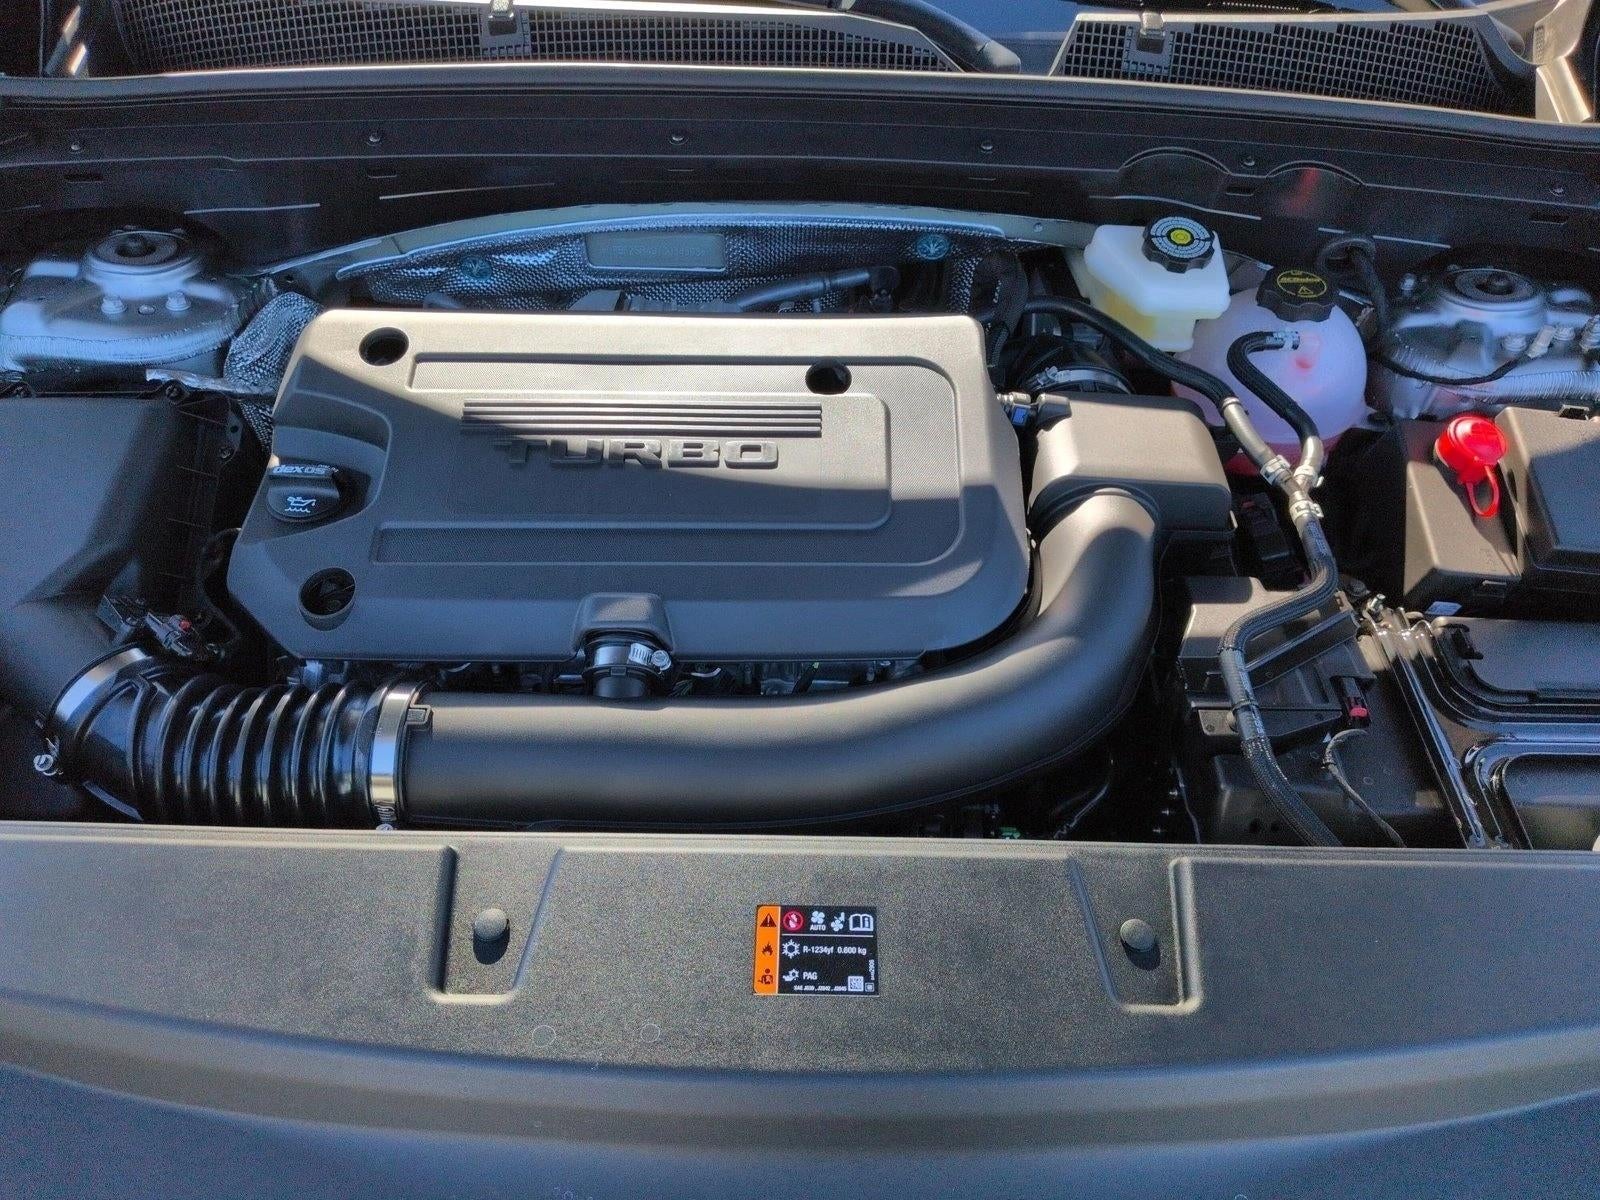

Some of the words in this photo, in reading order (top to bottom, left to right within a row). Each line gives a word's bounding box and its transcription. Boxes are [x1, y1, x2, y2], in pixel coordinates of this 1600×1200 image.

[494, 439, 779, 469] TURBO
[272, 465, 326, 475] dexos
[802, 945, 834, 955] R-1234yf
[857, 947, 867, 955] kg
[802, 971, 818, 980] PAG
